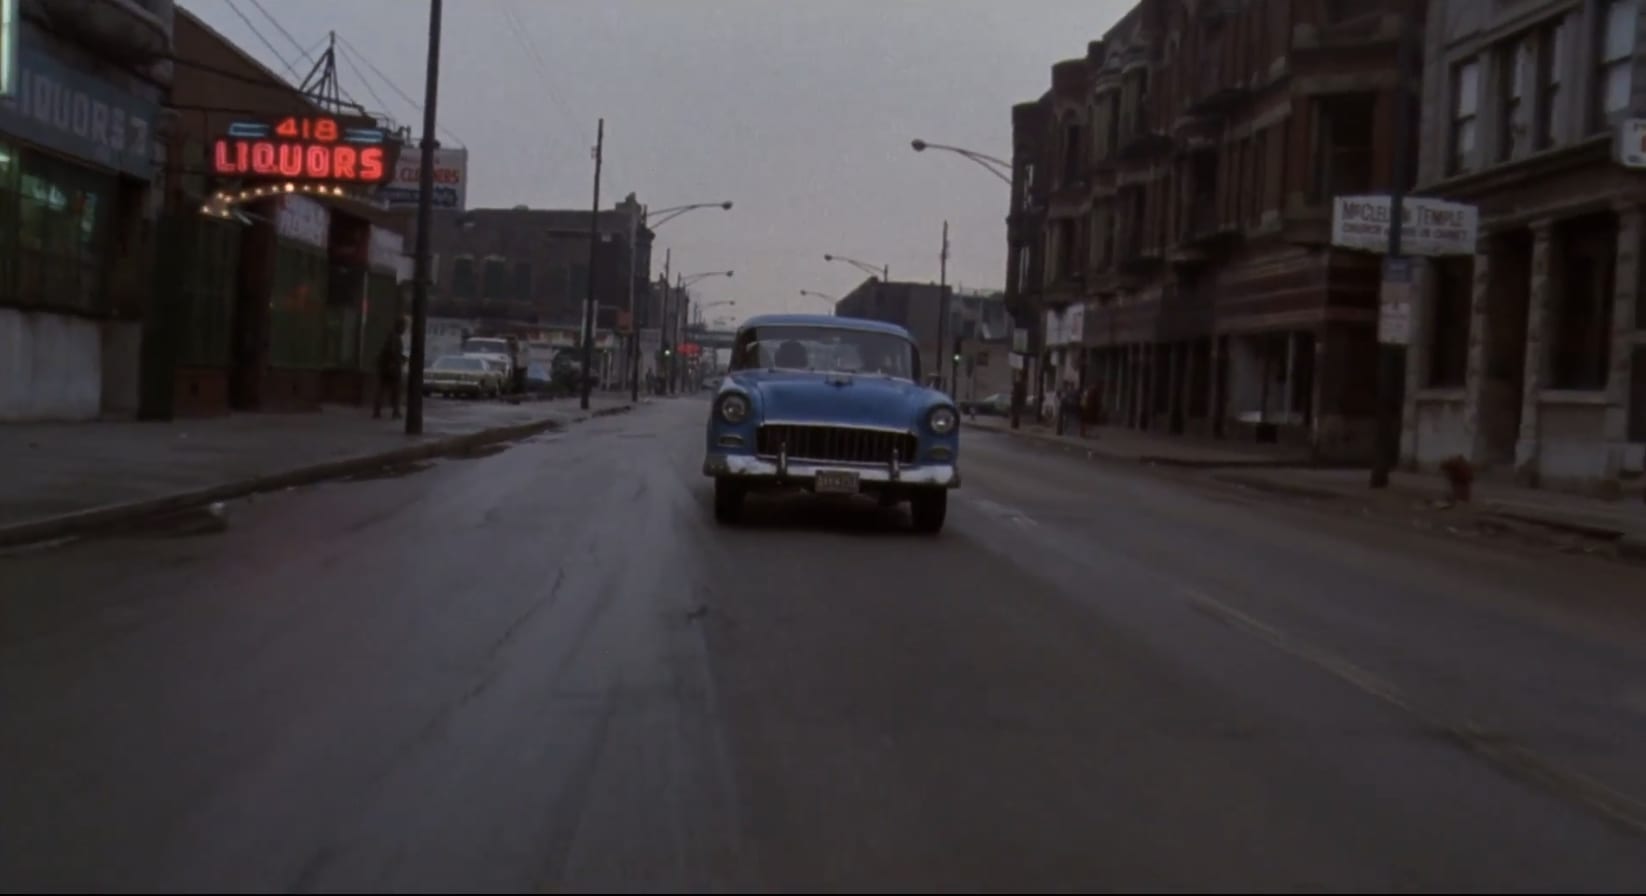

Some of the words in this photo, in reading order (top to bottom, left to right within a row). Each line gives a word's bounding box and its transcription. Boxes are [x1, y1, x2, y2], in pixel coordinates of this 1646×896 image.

[274, 117, 339, 141] 418
[214, 140, 383, 180] LIQUORS
[400, 167, 460, 185] CLENERS
